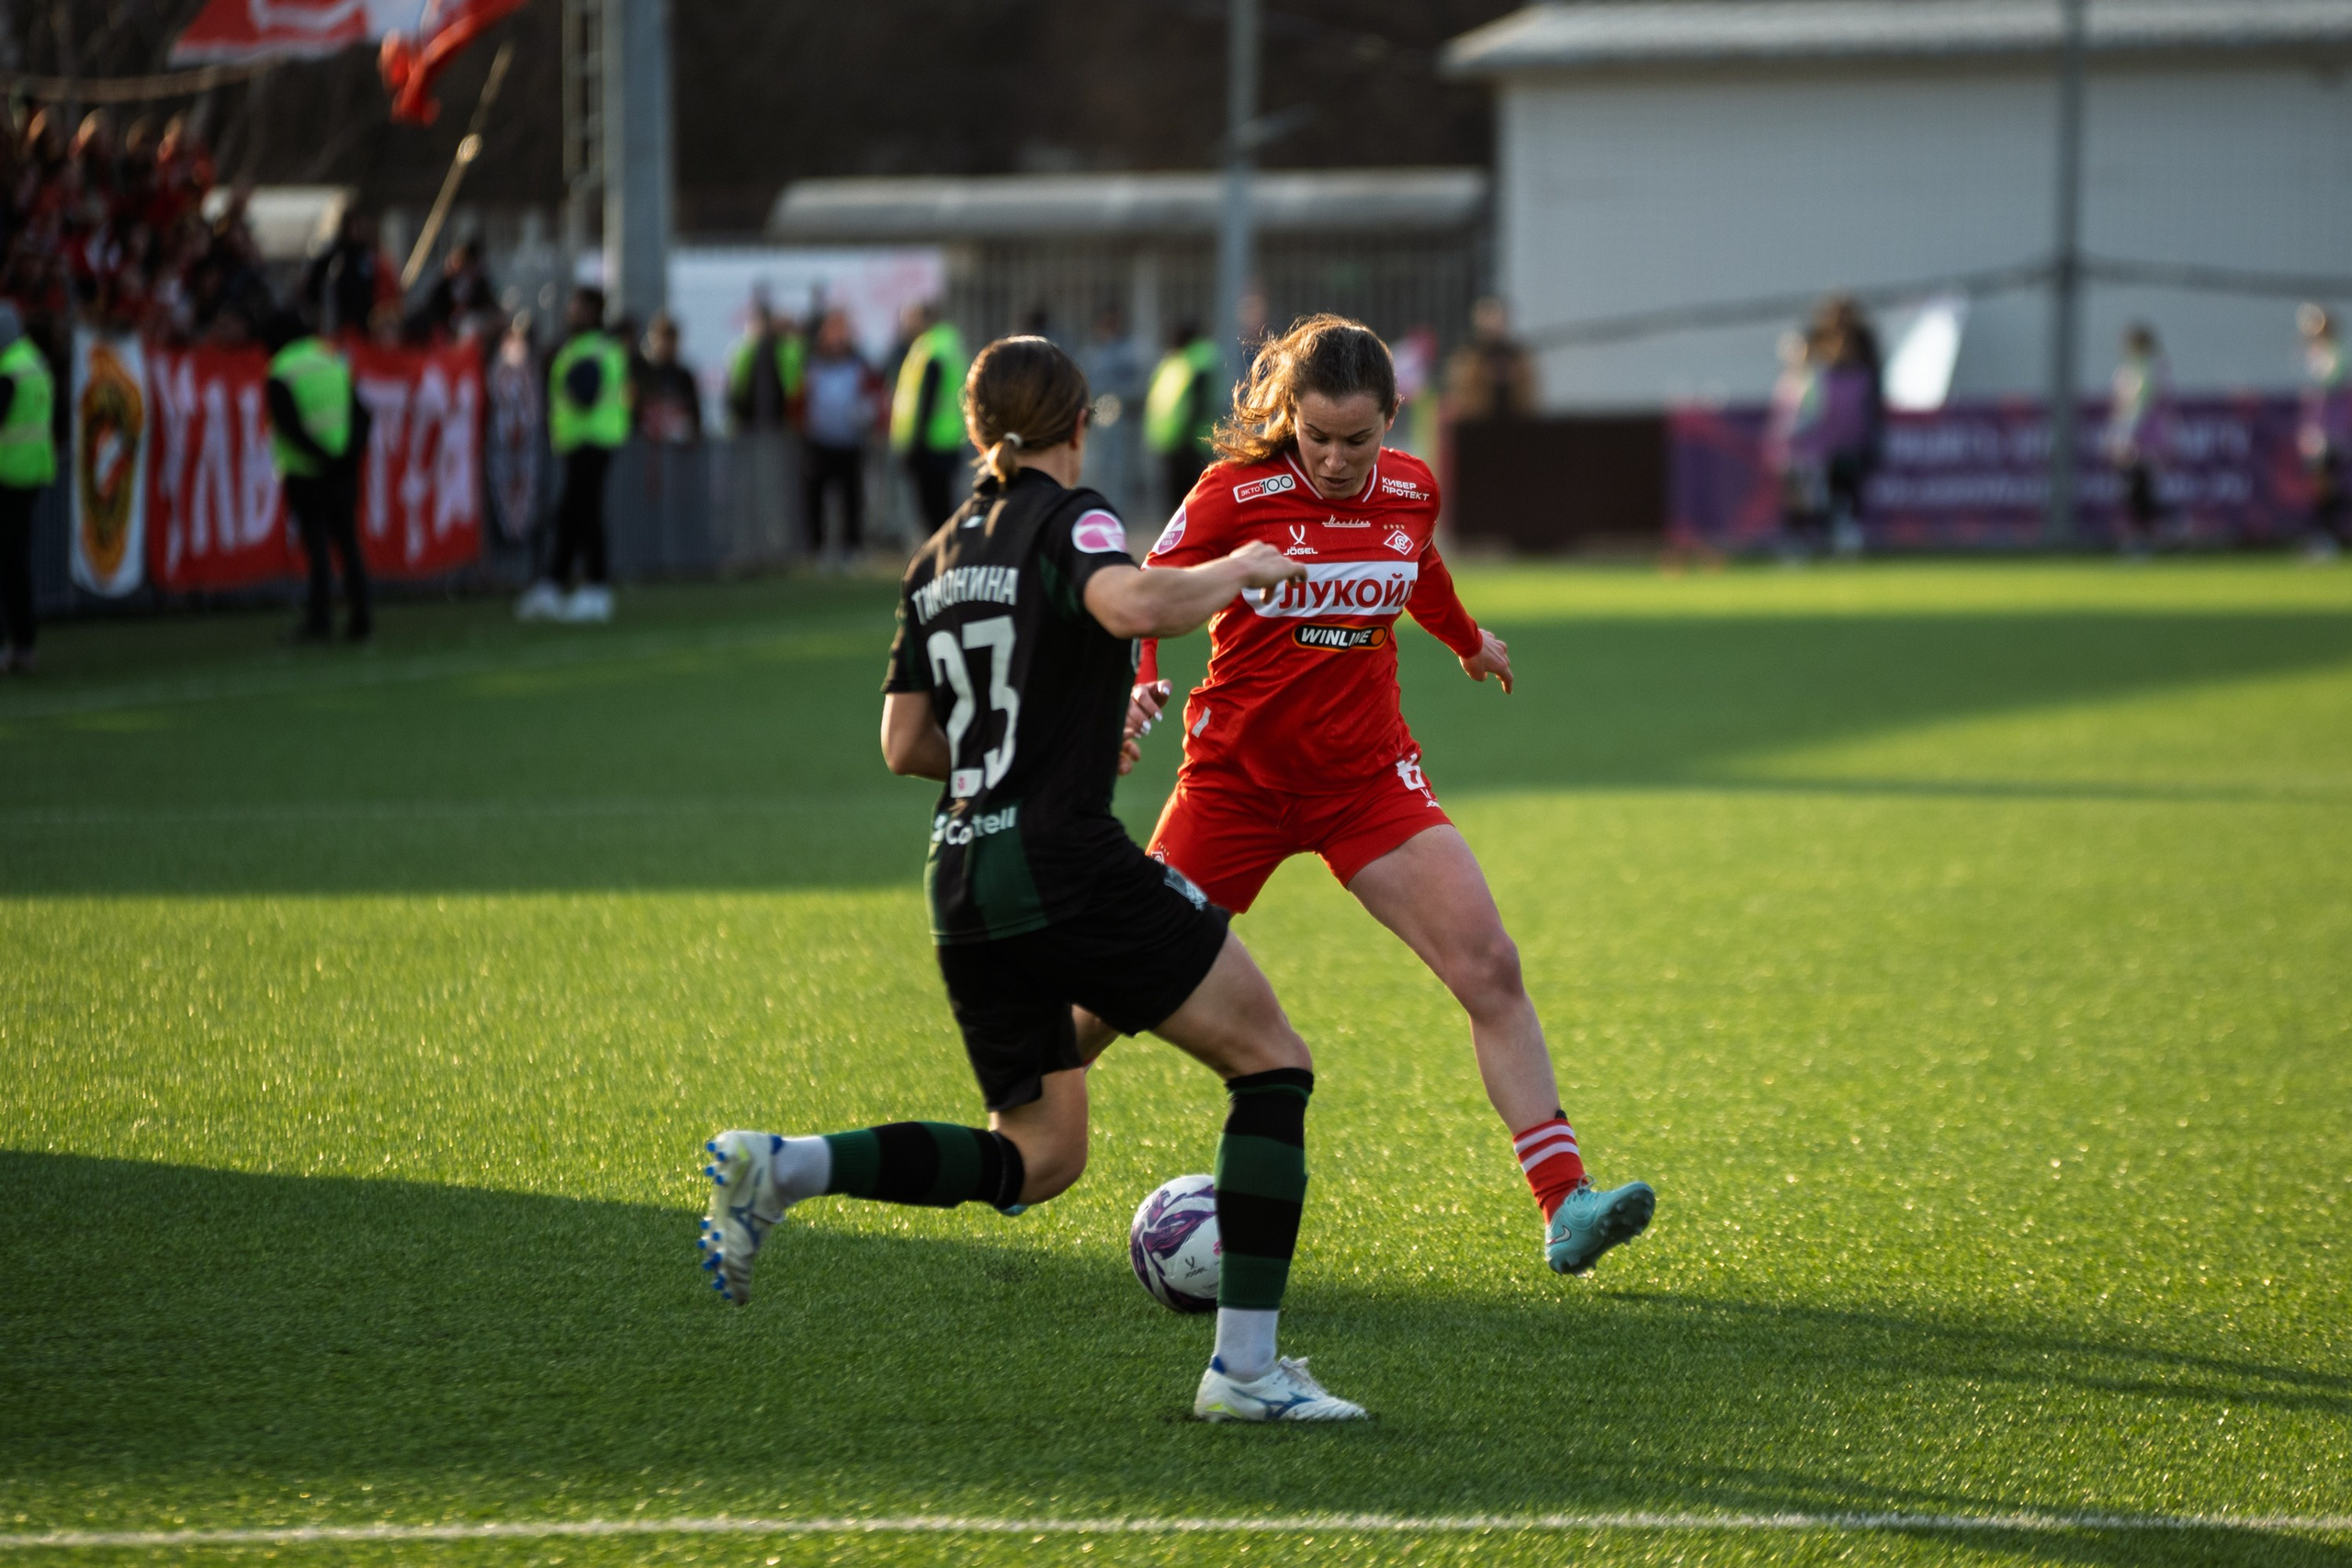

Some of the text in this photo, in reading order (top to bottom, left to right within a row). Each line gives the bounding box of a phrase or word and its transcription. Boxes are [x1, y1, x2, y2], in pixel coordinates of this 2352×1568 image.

[1261, 475, 1294, 494] 100
[1382, 476, 1417, 490] КИБЕР
[1382, 485, 1430, 501] ПРОТЕКТ
[1283, 547, 1318, 556] JÖGEL
[911, 565, 1019, 626] ТИМОНИНА
[1301, 627, 1372, 647] WINLINE
[927, 615, 1020, 798] 23
